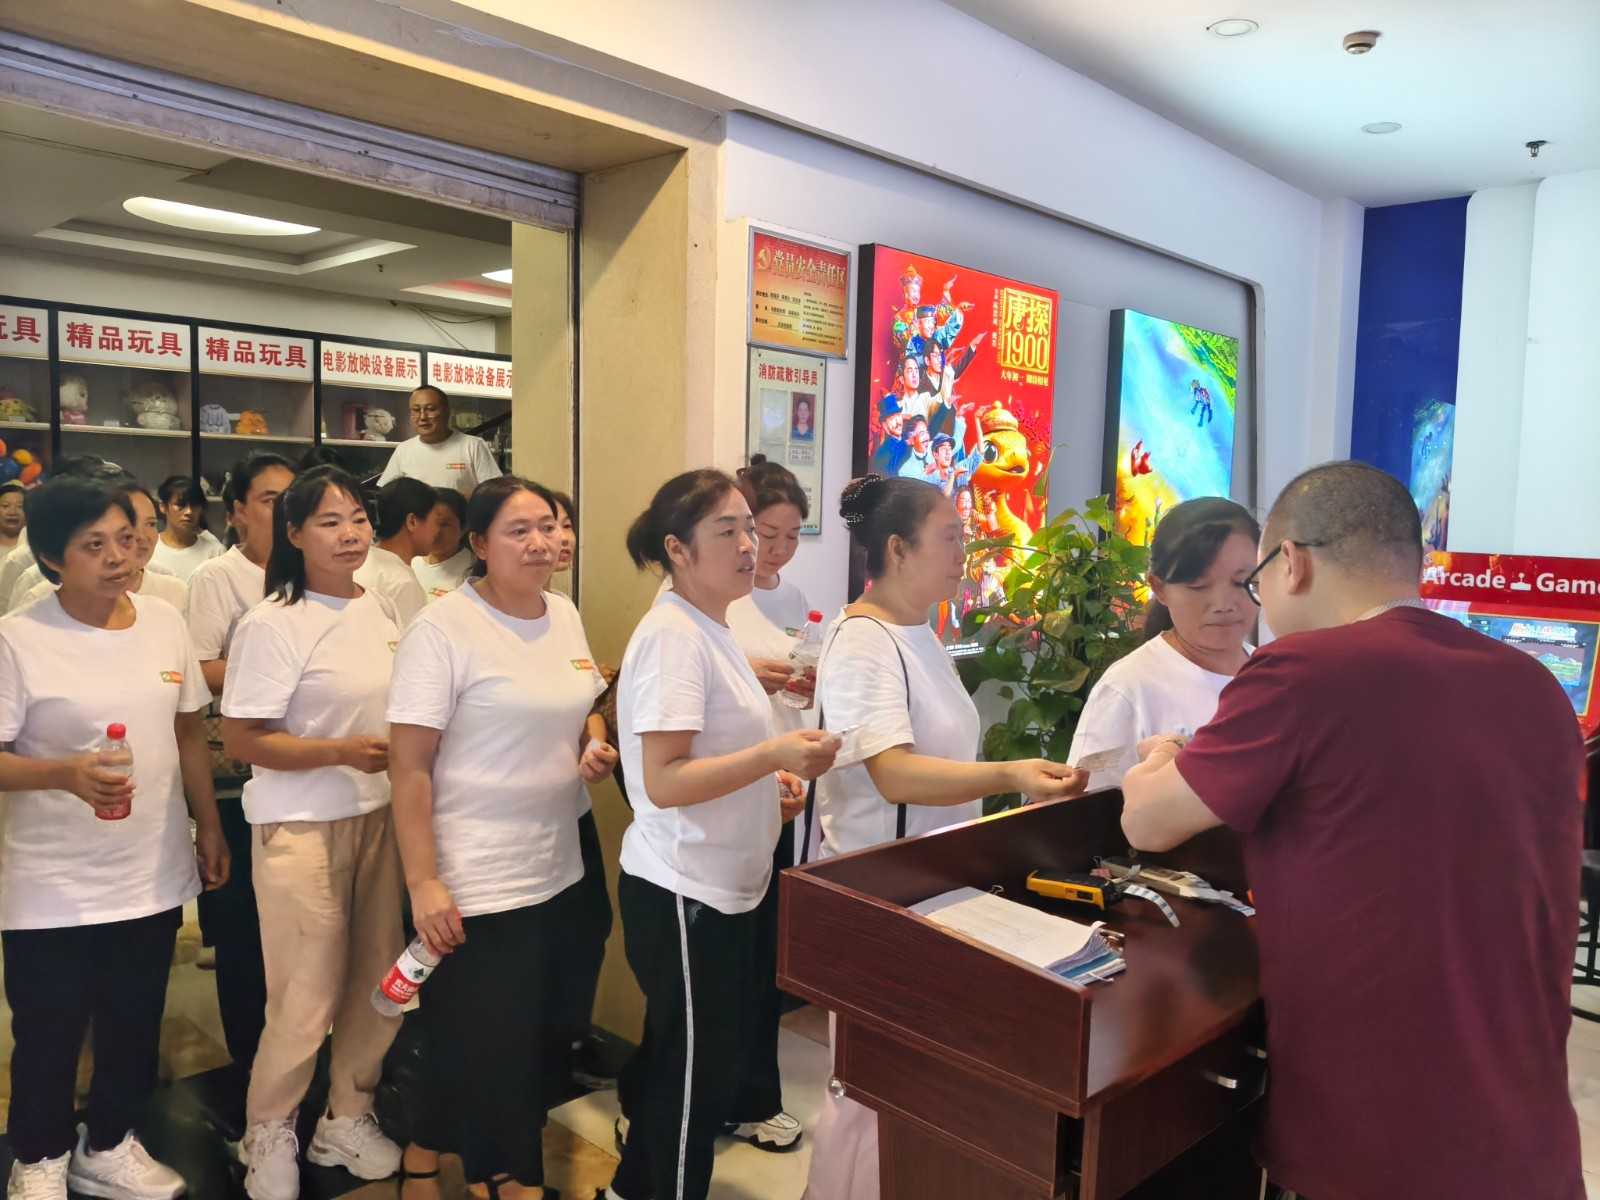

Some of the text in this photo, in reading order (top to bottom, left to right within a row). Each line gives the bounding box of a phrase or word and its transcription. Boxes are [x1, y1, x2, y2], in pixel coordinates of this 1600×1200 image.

[1005, 295, 1049, 335] 唐探
[66, 321, 183, 357] 精品玩具
[206, 337, 308, 369] 精品玩具
[1004, 331, 1048, 370] 1900
[323, 349, 418, 380] 电影放映设备展示
[758, 363, 818, 386] 消防疏散引导员
[1422, 567, 1600, 595] Arcade Gam
